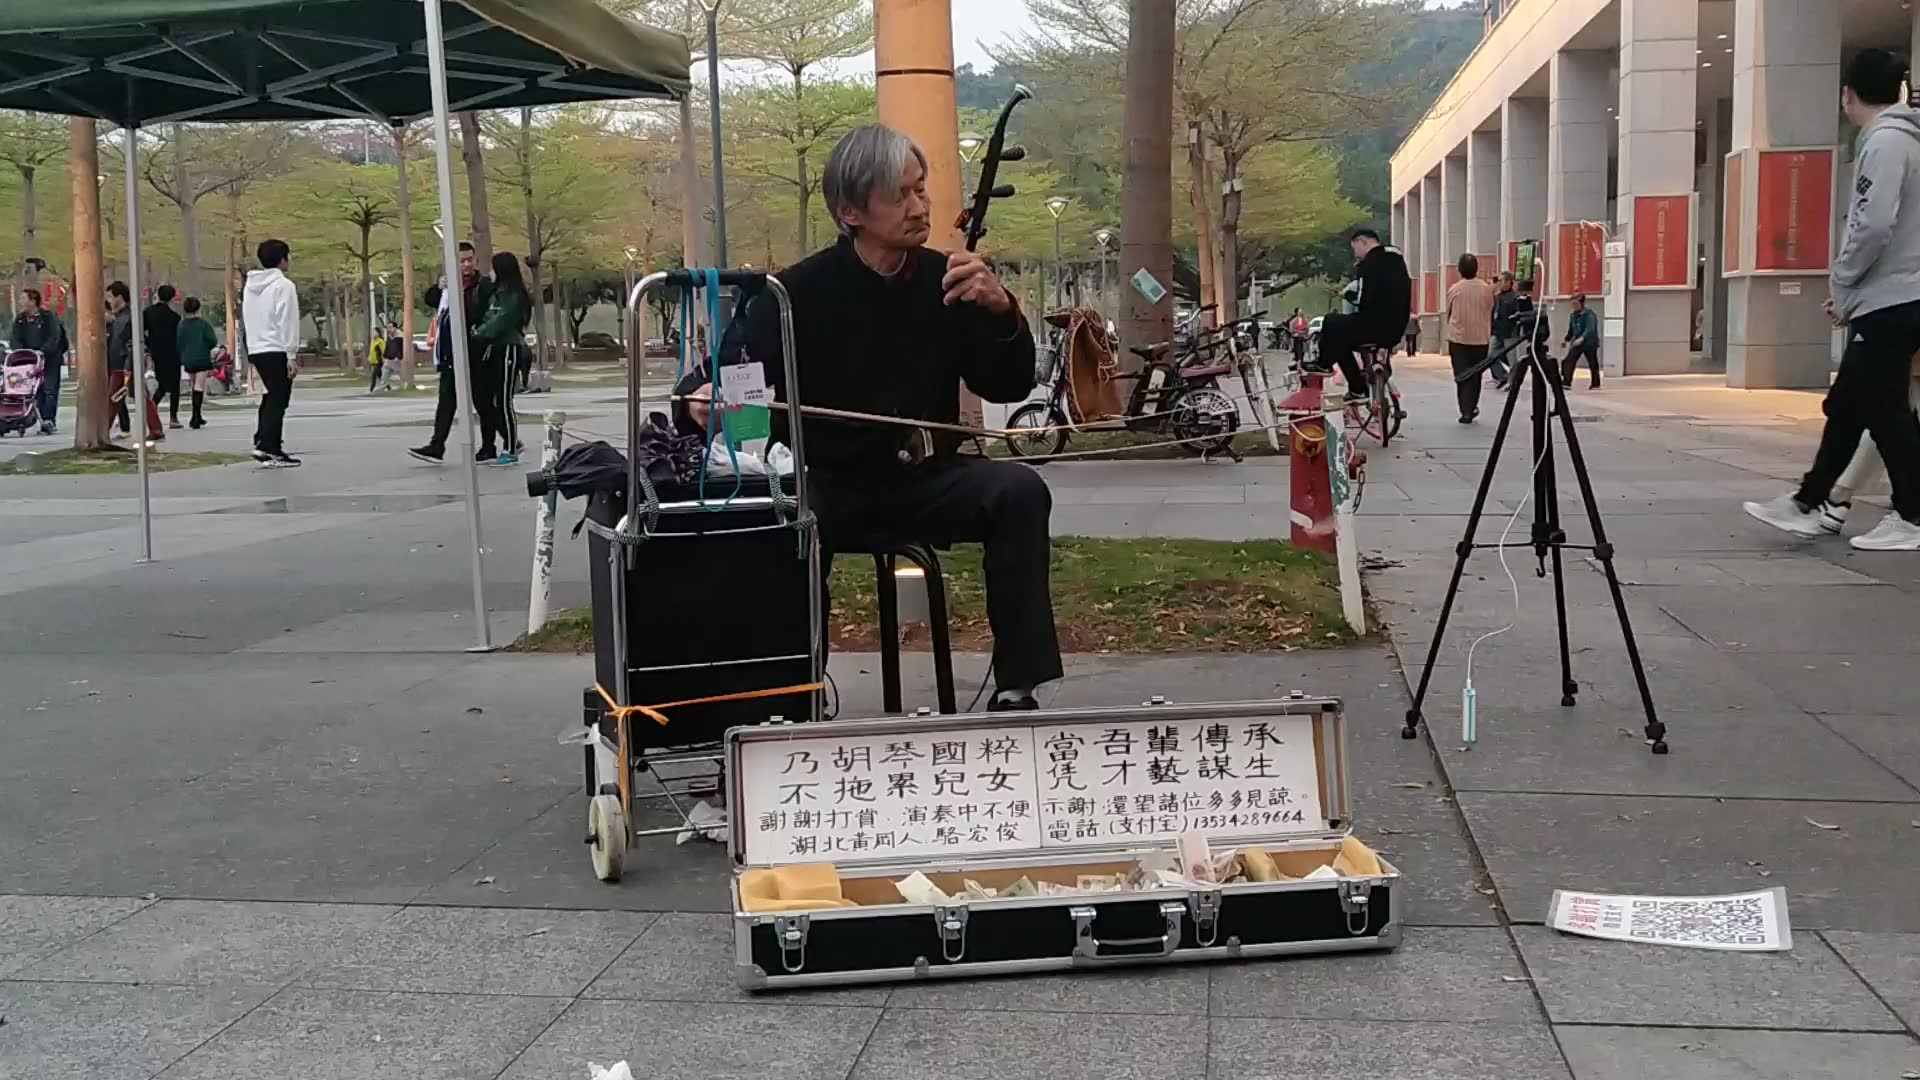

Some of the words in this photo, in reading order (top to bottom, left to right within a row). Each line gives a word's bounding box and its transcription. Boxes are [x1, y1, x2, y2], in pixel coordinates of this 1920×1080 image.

[779, 735, 1023, 774] 乃胡琴國粹
[1044, 722, 1286, 763] 當吾輩傳承
[778, 767, 1022, 804] 不拖累兒女
